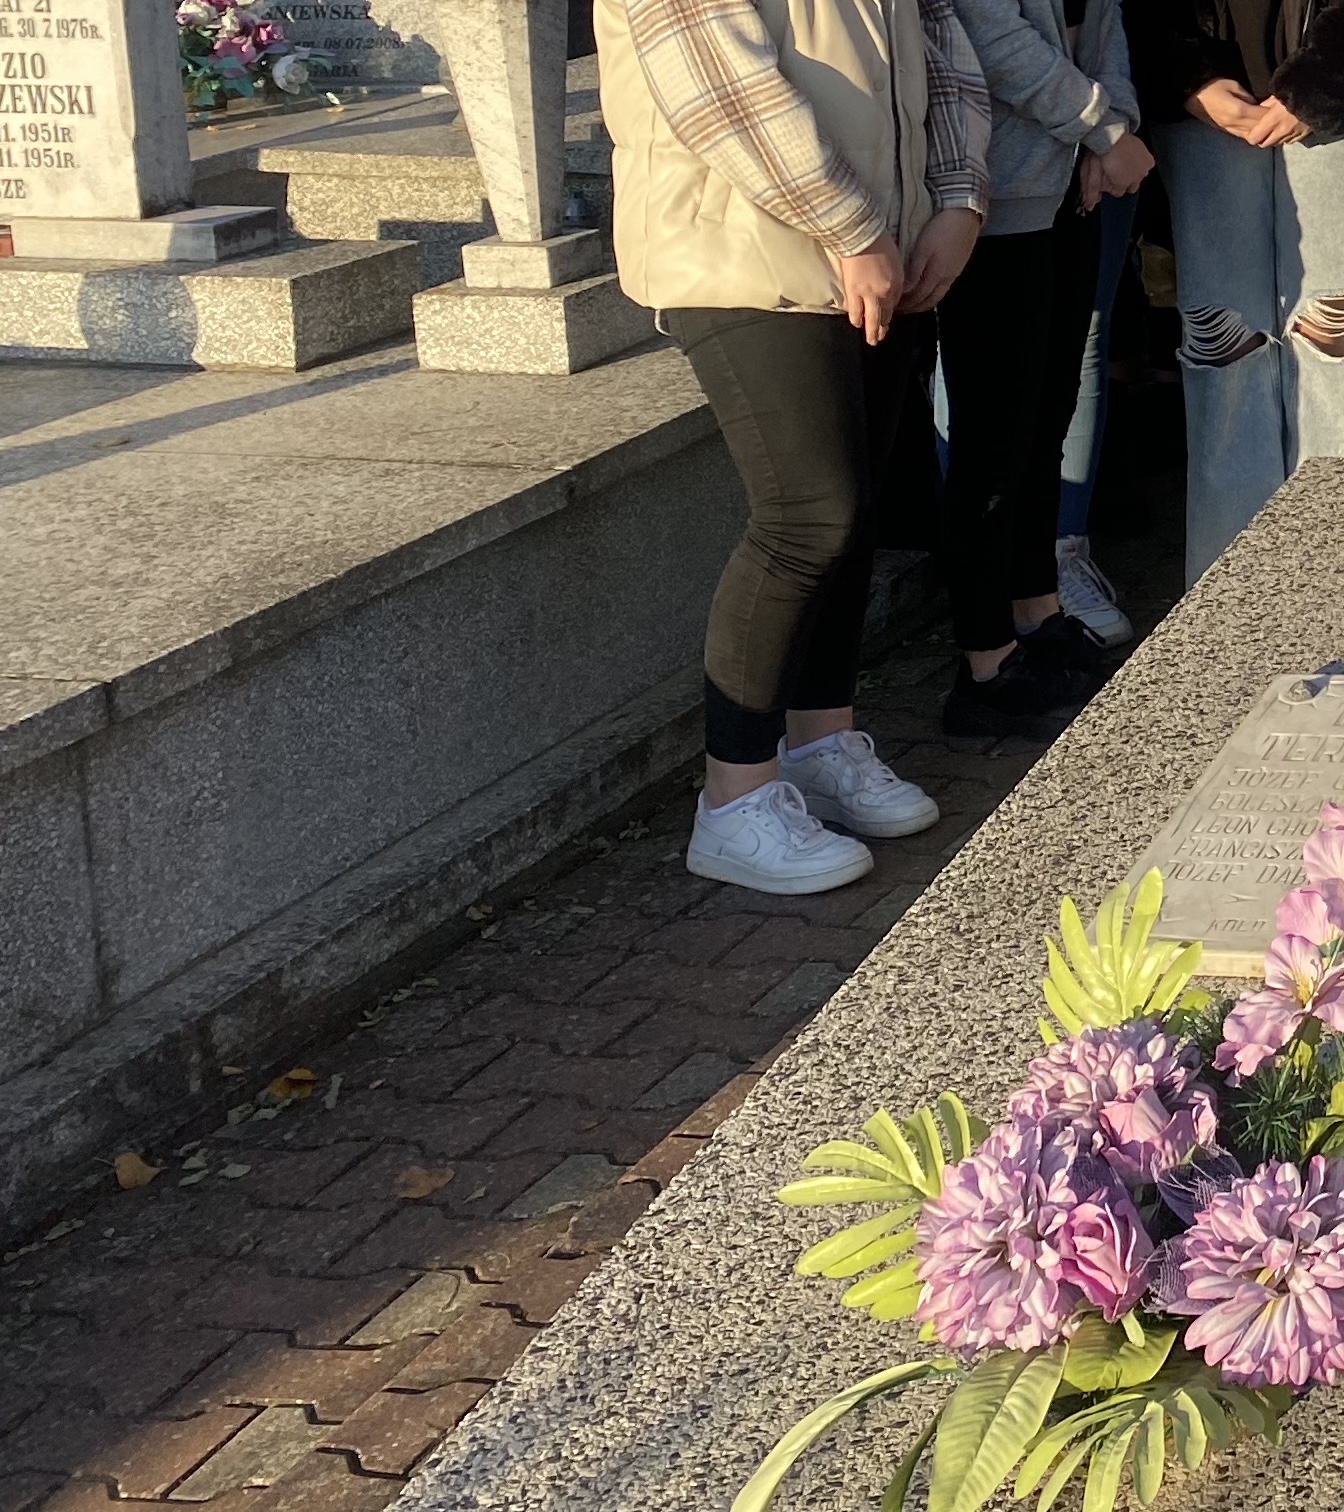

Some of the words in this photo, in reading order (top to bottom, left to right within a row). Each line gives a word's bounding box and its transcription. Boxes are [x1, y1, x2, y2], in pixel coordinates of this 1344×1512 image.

[0, 52, 47, 80] ZIO
[308, 64, 360, 78] ARIA
[0, 83, 96, 116] ZEWSKI
[0, 177, 27, 200] ZE
[1207, 790, 1340, 815] BOLESŁA
[1190, 813, 1261, 836] LEON
[1173, 837, 1305, 860] FRANCISZ
